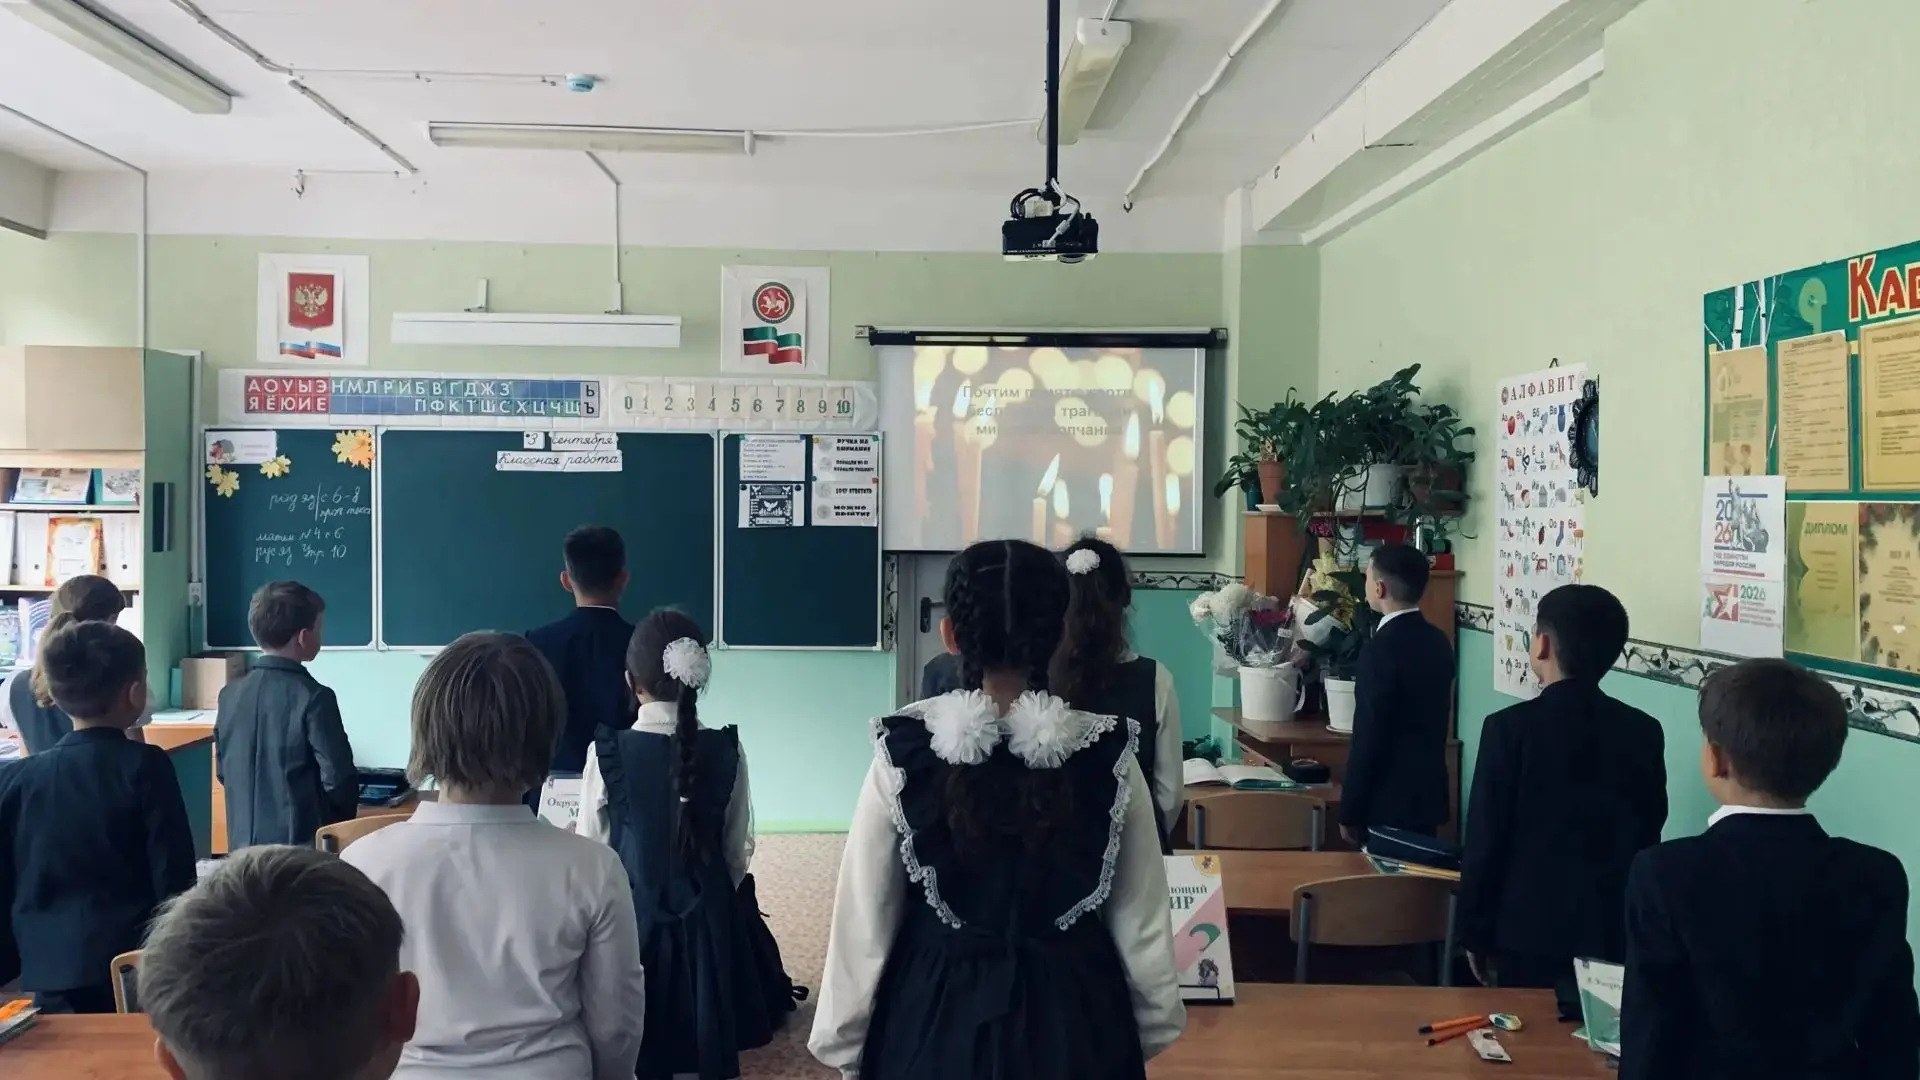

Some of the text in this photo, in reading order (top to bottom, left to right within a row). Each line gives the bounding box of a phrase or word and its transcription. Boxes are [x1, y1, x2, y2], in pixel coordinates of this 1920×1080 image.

[1510, 375, 1575, 401] АЛФАВИТ
[624, 396, 850, 414] 0 1 2 3 4 5 6 7 8 9 10
[528, 432, 613, 451] 3 сентября
[499, 451, 619, 470] Классная работа
[1716, 499, 1733, 521] 20
[1714, 521, 1732, 544] 26
[1805, 522, 1848, 536] ДИПЛОМ
[331, 544, 347, 559] 10
[1740, 584, 1766, 601] 2026
[547, 797, 579, 808] Окруж
[1170, 884, 1207, 895] ющий
[1170, 896, 1194, 909] ИР
